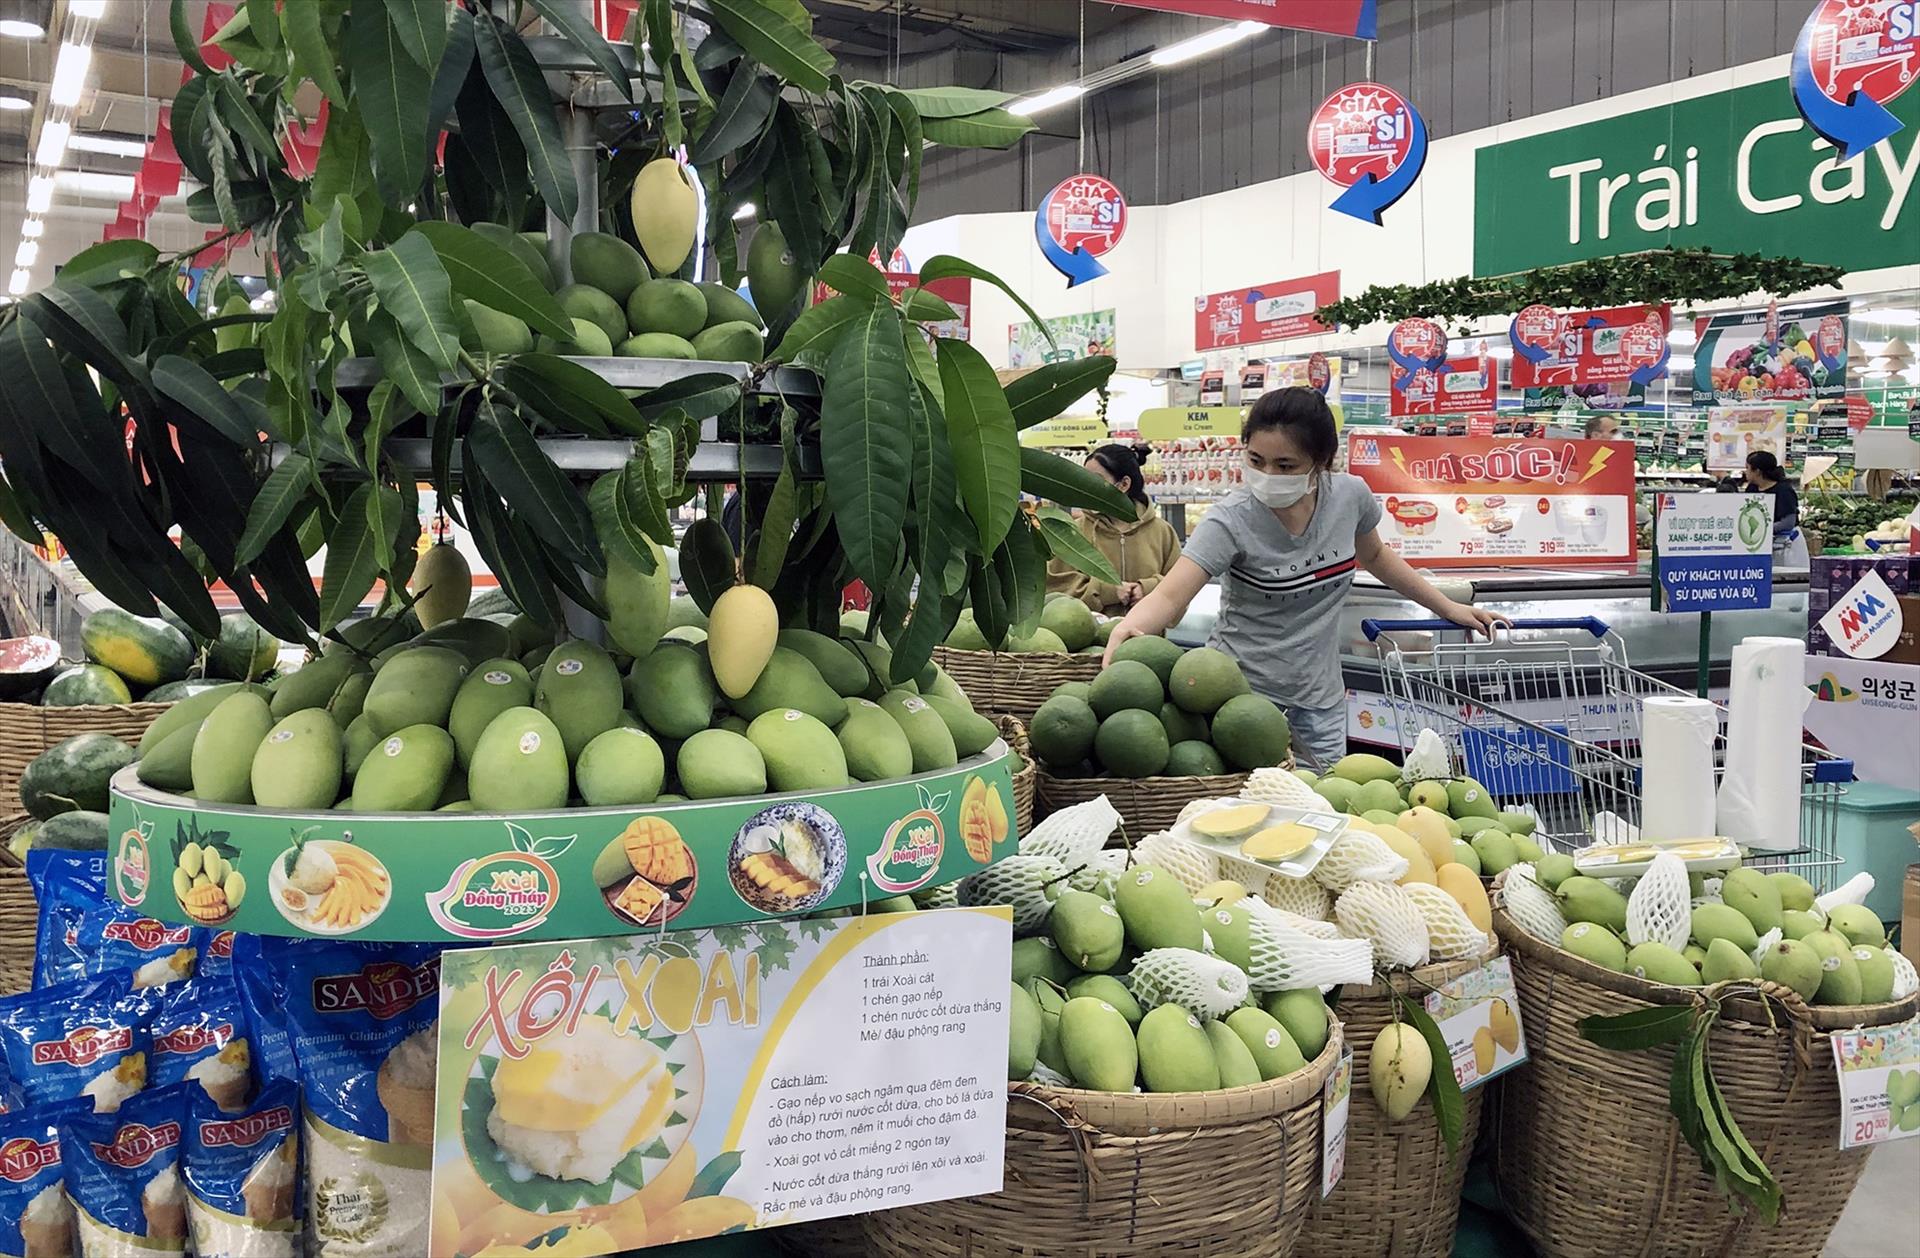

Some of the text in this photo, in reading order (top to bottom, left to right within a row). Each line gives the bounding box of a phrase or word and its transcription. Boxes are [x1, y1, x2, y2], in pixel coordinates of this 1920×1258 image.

[1549, 144, 1701, 245] Trái
[1187, 412, 1208, 421] KEM
[1410, 453, 1456, 480] GIÁ
[1460, 542, 1473, 554] 79
[1540, 541, 1556, 553] 319
[1668, 533, 1688, 542] XANH
[1694, 533, 1713, 543] SẠCH
[1275, 550, 1338, 575] TOMMY
[1668, 568, 1687, 583] QUÝ
[1689, 568, 1720, 581] KHÁCH
[1723, 569, 1738, 580] VUI
[1692, 588, 1716, 602] DỤNG
[1862, 677, 1916, 701] 의성군
[1861, 699, 1918, 711] UISEONG-GUN
[463, 888, 549, 910] Đồng Tháp
[504, 905, 537, 915] 2023
[863, 954, 897, 968] Thành
[864, 972, 935, 988] 1 trái Xoài cát
[863, 987, 943, 1006] 1 chén gạo nếp
[862, 1013, 866, 1023] 1
[871, 1011, 898, 1023] chén
[902, 1008, 929, 1020] nước
[931, 1003, 946, 1016] cốt
[296, 1032, 346, 1048] Premium
[350, 1026, 403, 1041] Glutinous
[884, 1028, 905, 1040] đậu
[908, 1024, 939, 1039] phộng
[942, 1022, 966, 1033] rang
[771, 1074, 828, 1090] Cách làm:
[777, 1076, 977, 1110] Gạo nếp vo sạch ngâm qua đêm đem
[846, 1106, 874, 1118] nước
[877, 1099, 892, 1113] cốt
[925, 1097, 943, 1108] cho
[205, 1109, 290, 1144] SANDEE
[768, 1134, 788, 1146] vào
[791, 1131, 812, 1143] cho
[887, 1115, 913, 1129] muối
[916, 1115, 936, 1127] cho
[939, 1112, 960, 1124] đậm
[1855, 1120, 1873, 1141] 20
[774, 1154, 799, 1168] Xoài
[802, 1153, 820, 1166] gọt
[824, 1149, 837, 1160] vỏ
[860, 1140, 892, 1154] miếng
[895, 1140, 901, 1151] 2
[905, 1137, 931, 1151] ngón
[935, 1135, 951, 1147] tay
[772, 1178, 804, 1192] Nước
[808, 1173, 825, 1187] cốt
[912, 1161, 928, 1171] lên
[931, 1158, 946, 1168] xôi
[949, 1156, 960, 1166] và
[335, 1191, 360, 1205] Thai
[789, 1199, 806, 1209] mè
[810, 1195, 823, 1206] và
[826, 1192, 846, 1204] đậu
[850, 1187, 883, 1202] phộng
